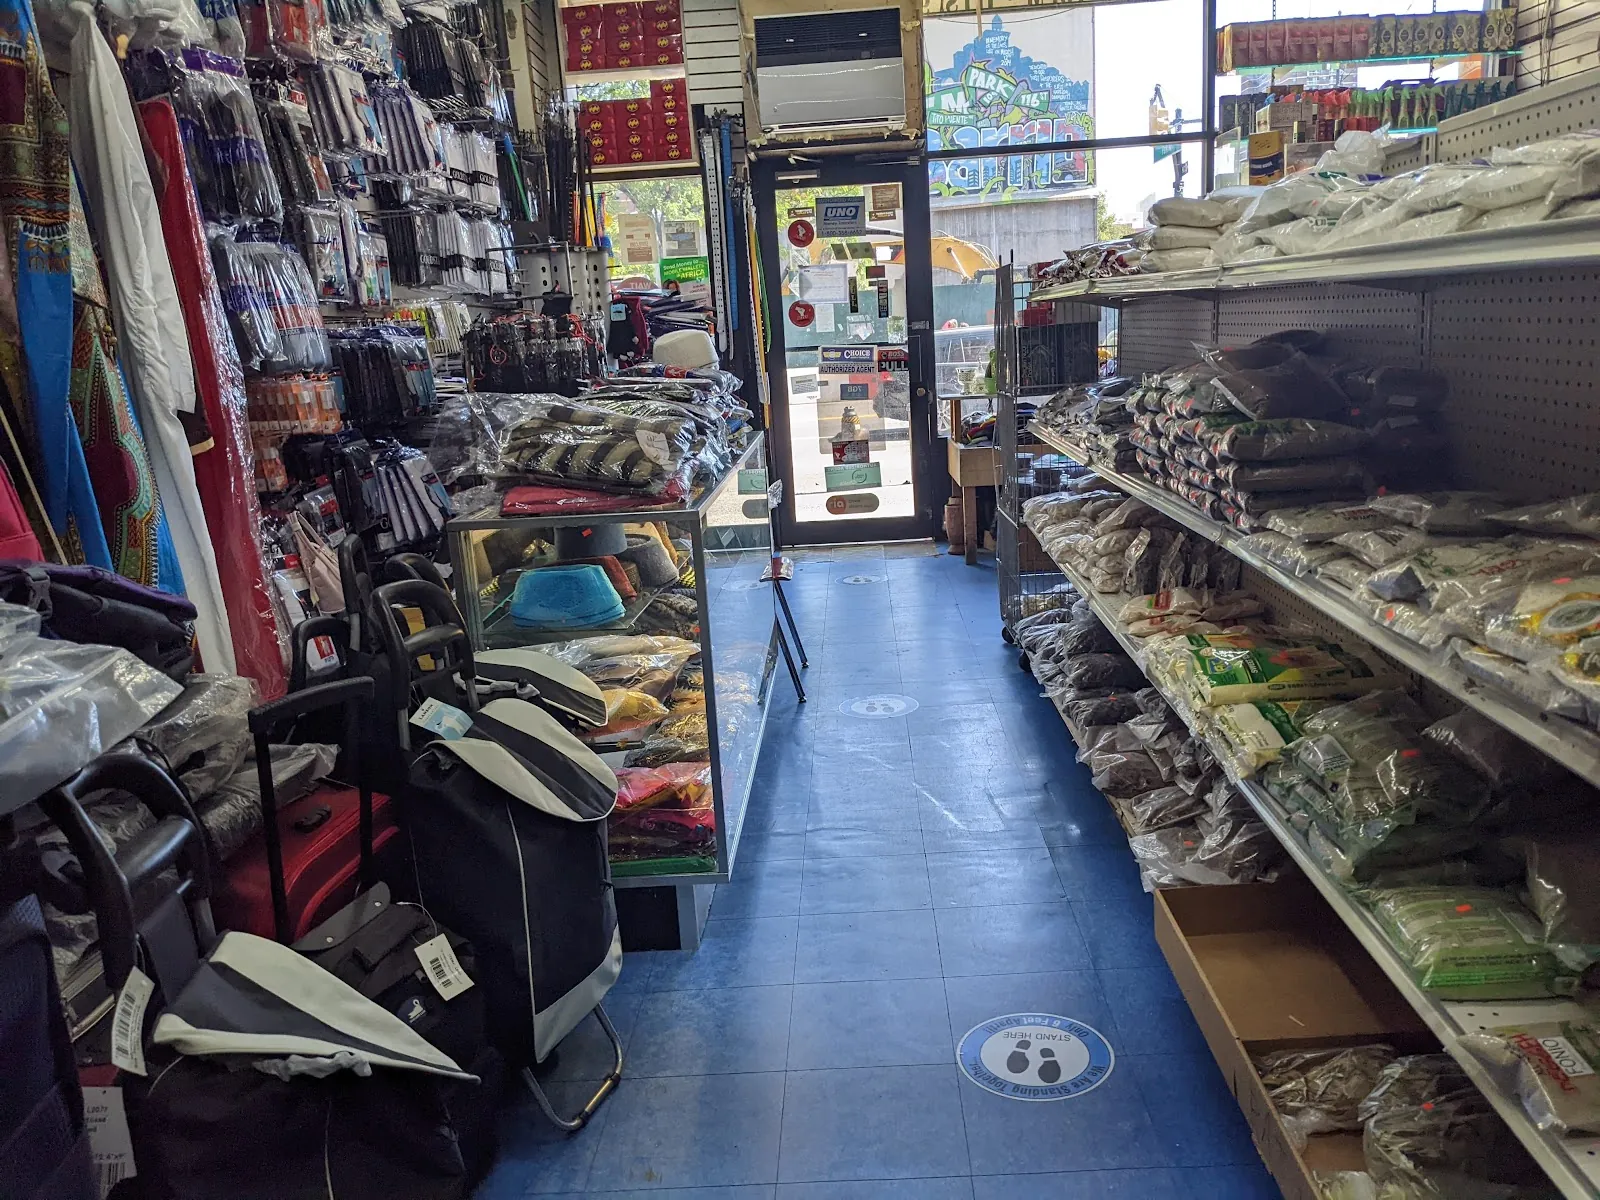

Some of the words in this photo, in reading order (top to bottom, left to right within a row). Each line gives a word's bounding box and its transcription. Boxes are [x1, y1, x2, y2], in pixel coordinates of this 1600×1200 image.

[968, 68, 1009, 98] PARK
[1019, 94, 1039, 107] 116
[826, 206, 857, 217] UNO
[680, 269, 705, 279] AFRICA
[843, 350, 871, 359] CHOICE
[820, 366, 855, 374] AUTHORIZED
[1242, 655, 1257, 674] SWEET
[1023, 1017, 1049, 1026] Feet
[1054, 1020, 1061, 1028] 6
[1003, 1031, 1032, 1040] HERE
[1066, 1023, 1089, 1038] Only
[1036, 1032, 1071, 1042] STAND
[1542, 1038, 1583, 1076] FONIO
[1092, 1065, 1106, 1077] We
[1075, 1077, 1093, 1089] Are
[1012, 1085, 1071, 1097] Standing
